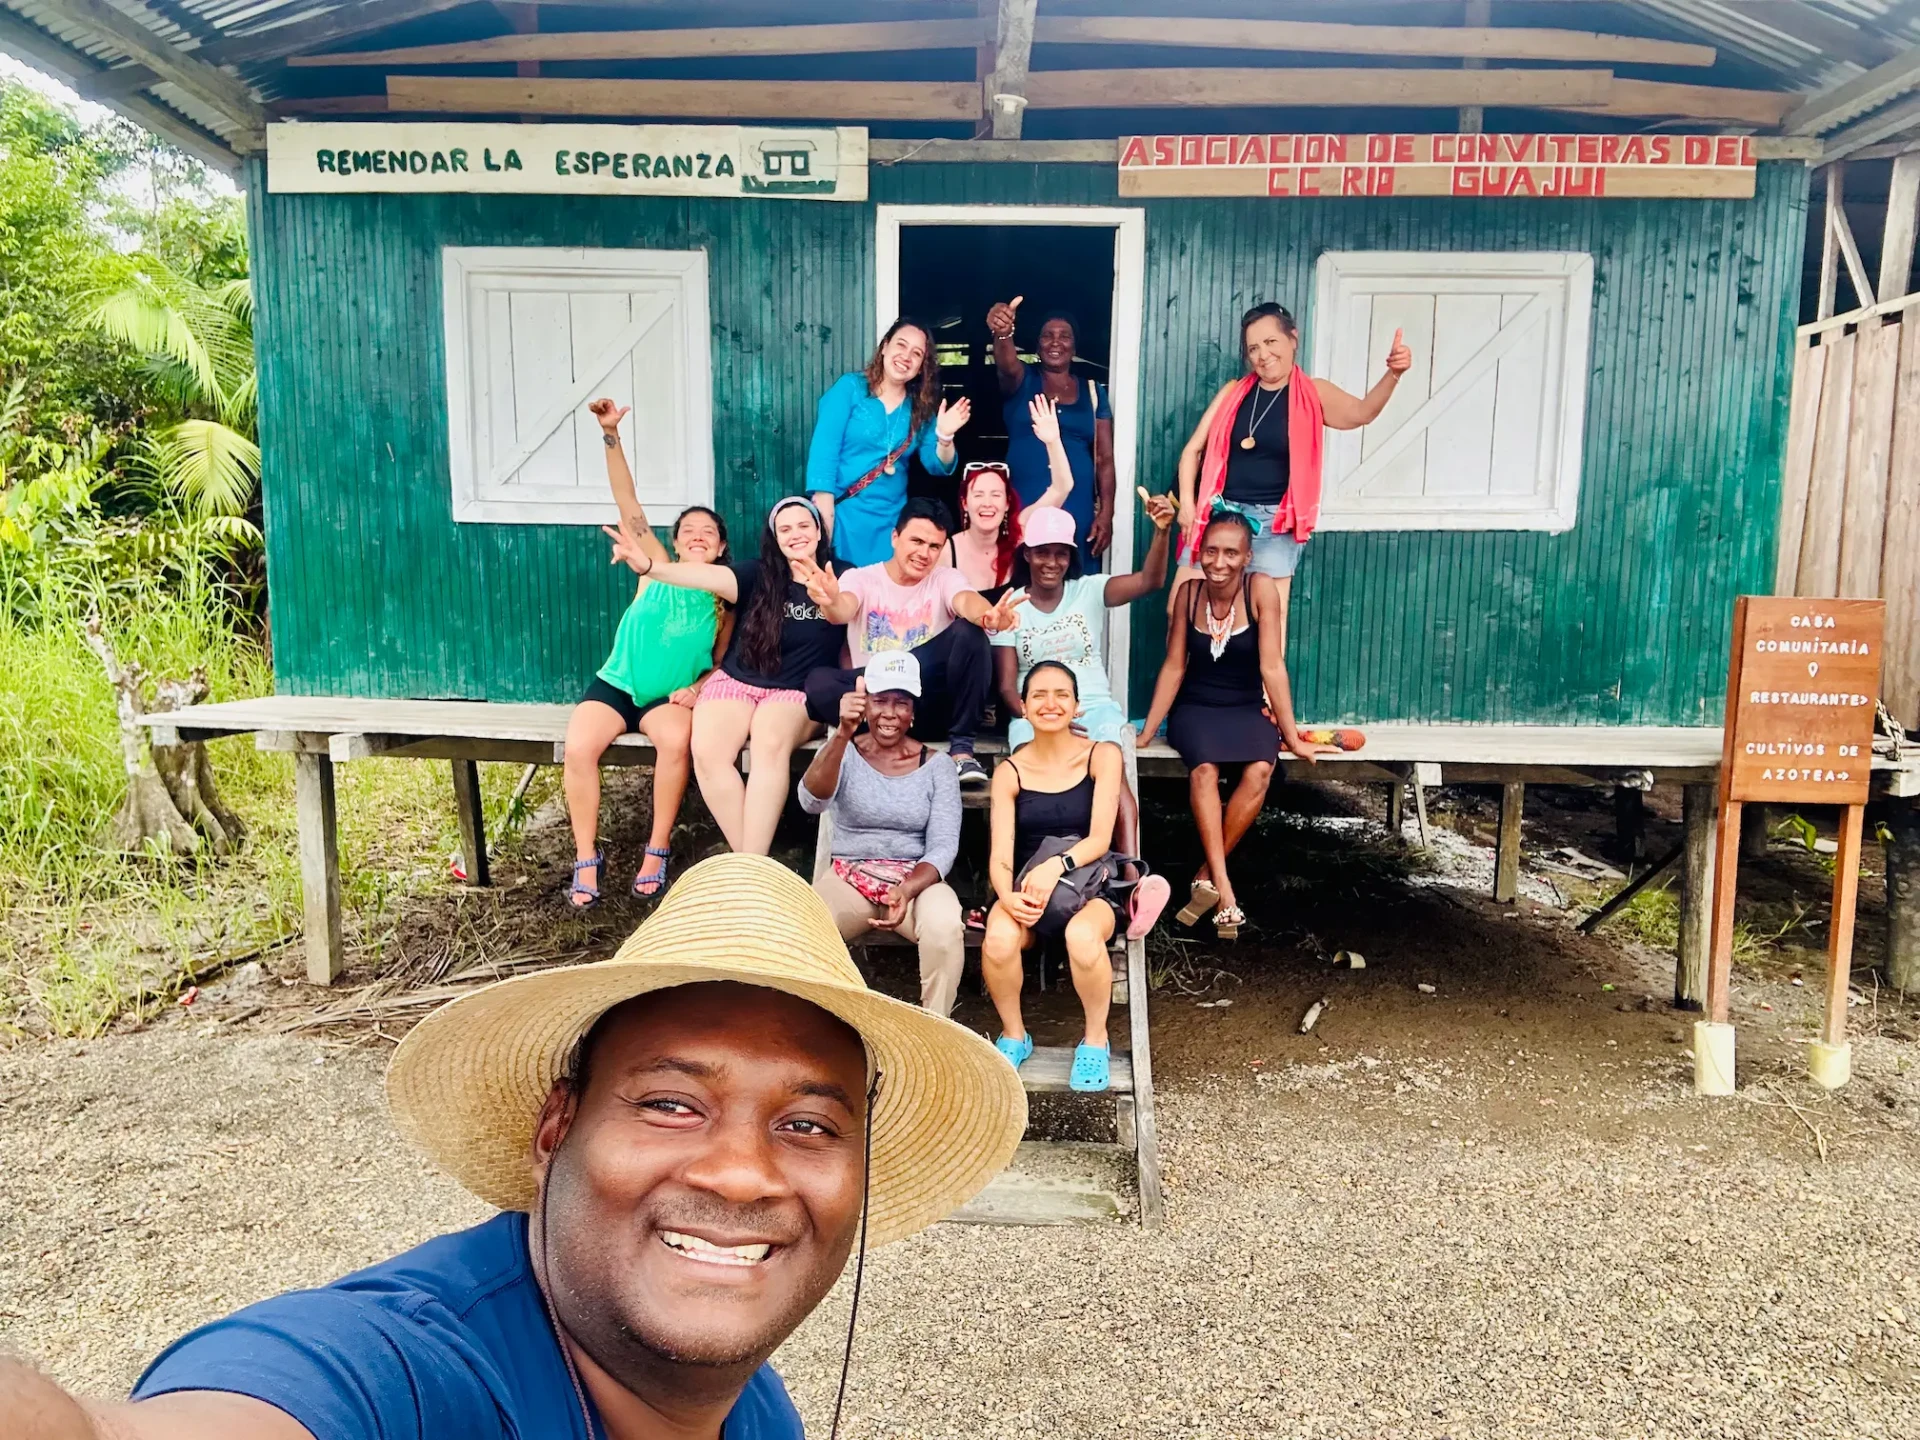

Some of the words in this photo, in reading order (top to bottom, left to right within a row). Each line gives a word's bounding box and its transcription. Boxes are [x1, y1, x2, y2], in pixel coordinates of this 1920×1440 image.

[1119, 134, 1347, 166] ASOCIACION
[1365, 134, 1416, 164] DE
[1431, 133, 1671, 164] CONVITERAS
[1682, 135, 1757, 166] DEL
[317, 148, 468, 176] REMENDAR
[484, 148, 523, 172] LA
[555, 150, 735, 179] ESPERANZA
[1451, 166, 1606, 197] GUAJUI
[1790, 616, 1836, 628] CASA
[1750, 691, 1860, 706] RESTAURANTE
[1839, 745, 1859, 757] DE
[1762, 768, 1835, 782] AZOTEA
